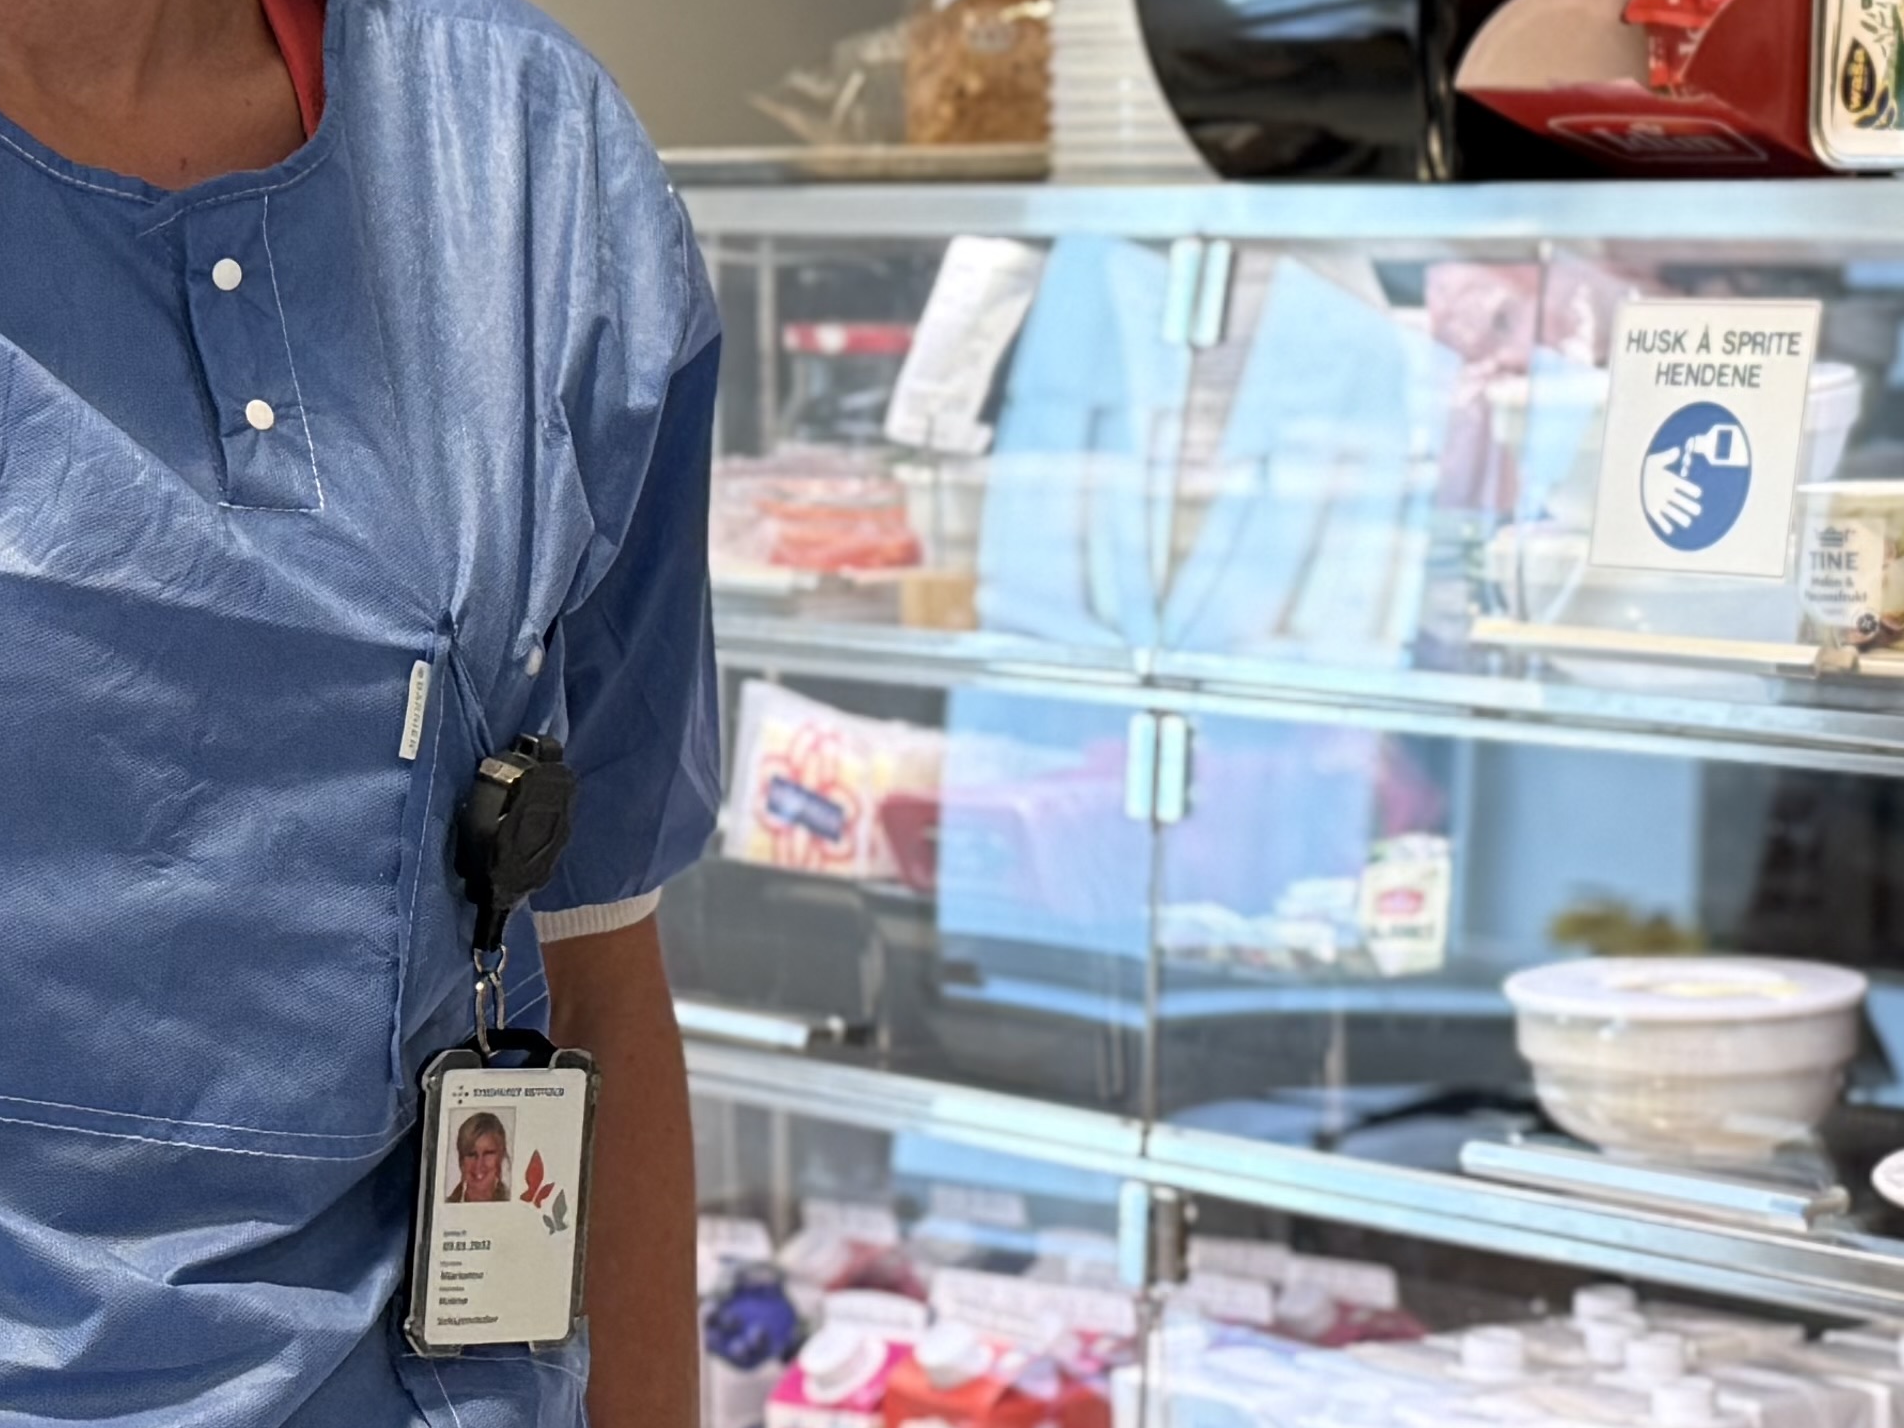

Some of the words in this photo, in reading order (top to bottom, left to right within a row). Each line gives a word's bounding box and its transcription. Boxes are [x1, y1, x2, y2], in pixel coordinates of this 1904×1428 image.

[1625, 328, 1689, 355] HUSK
[1696, 322, 1711, 355] Å
[1721, 329, 1802, 356] SPRITE
[1655, 361, 1763, 389] HENDENE
[1809, 551, 1859, 571] TINE
